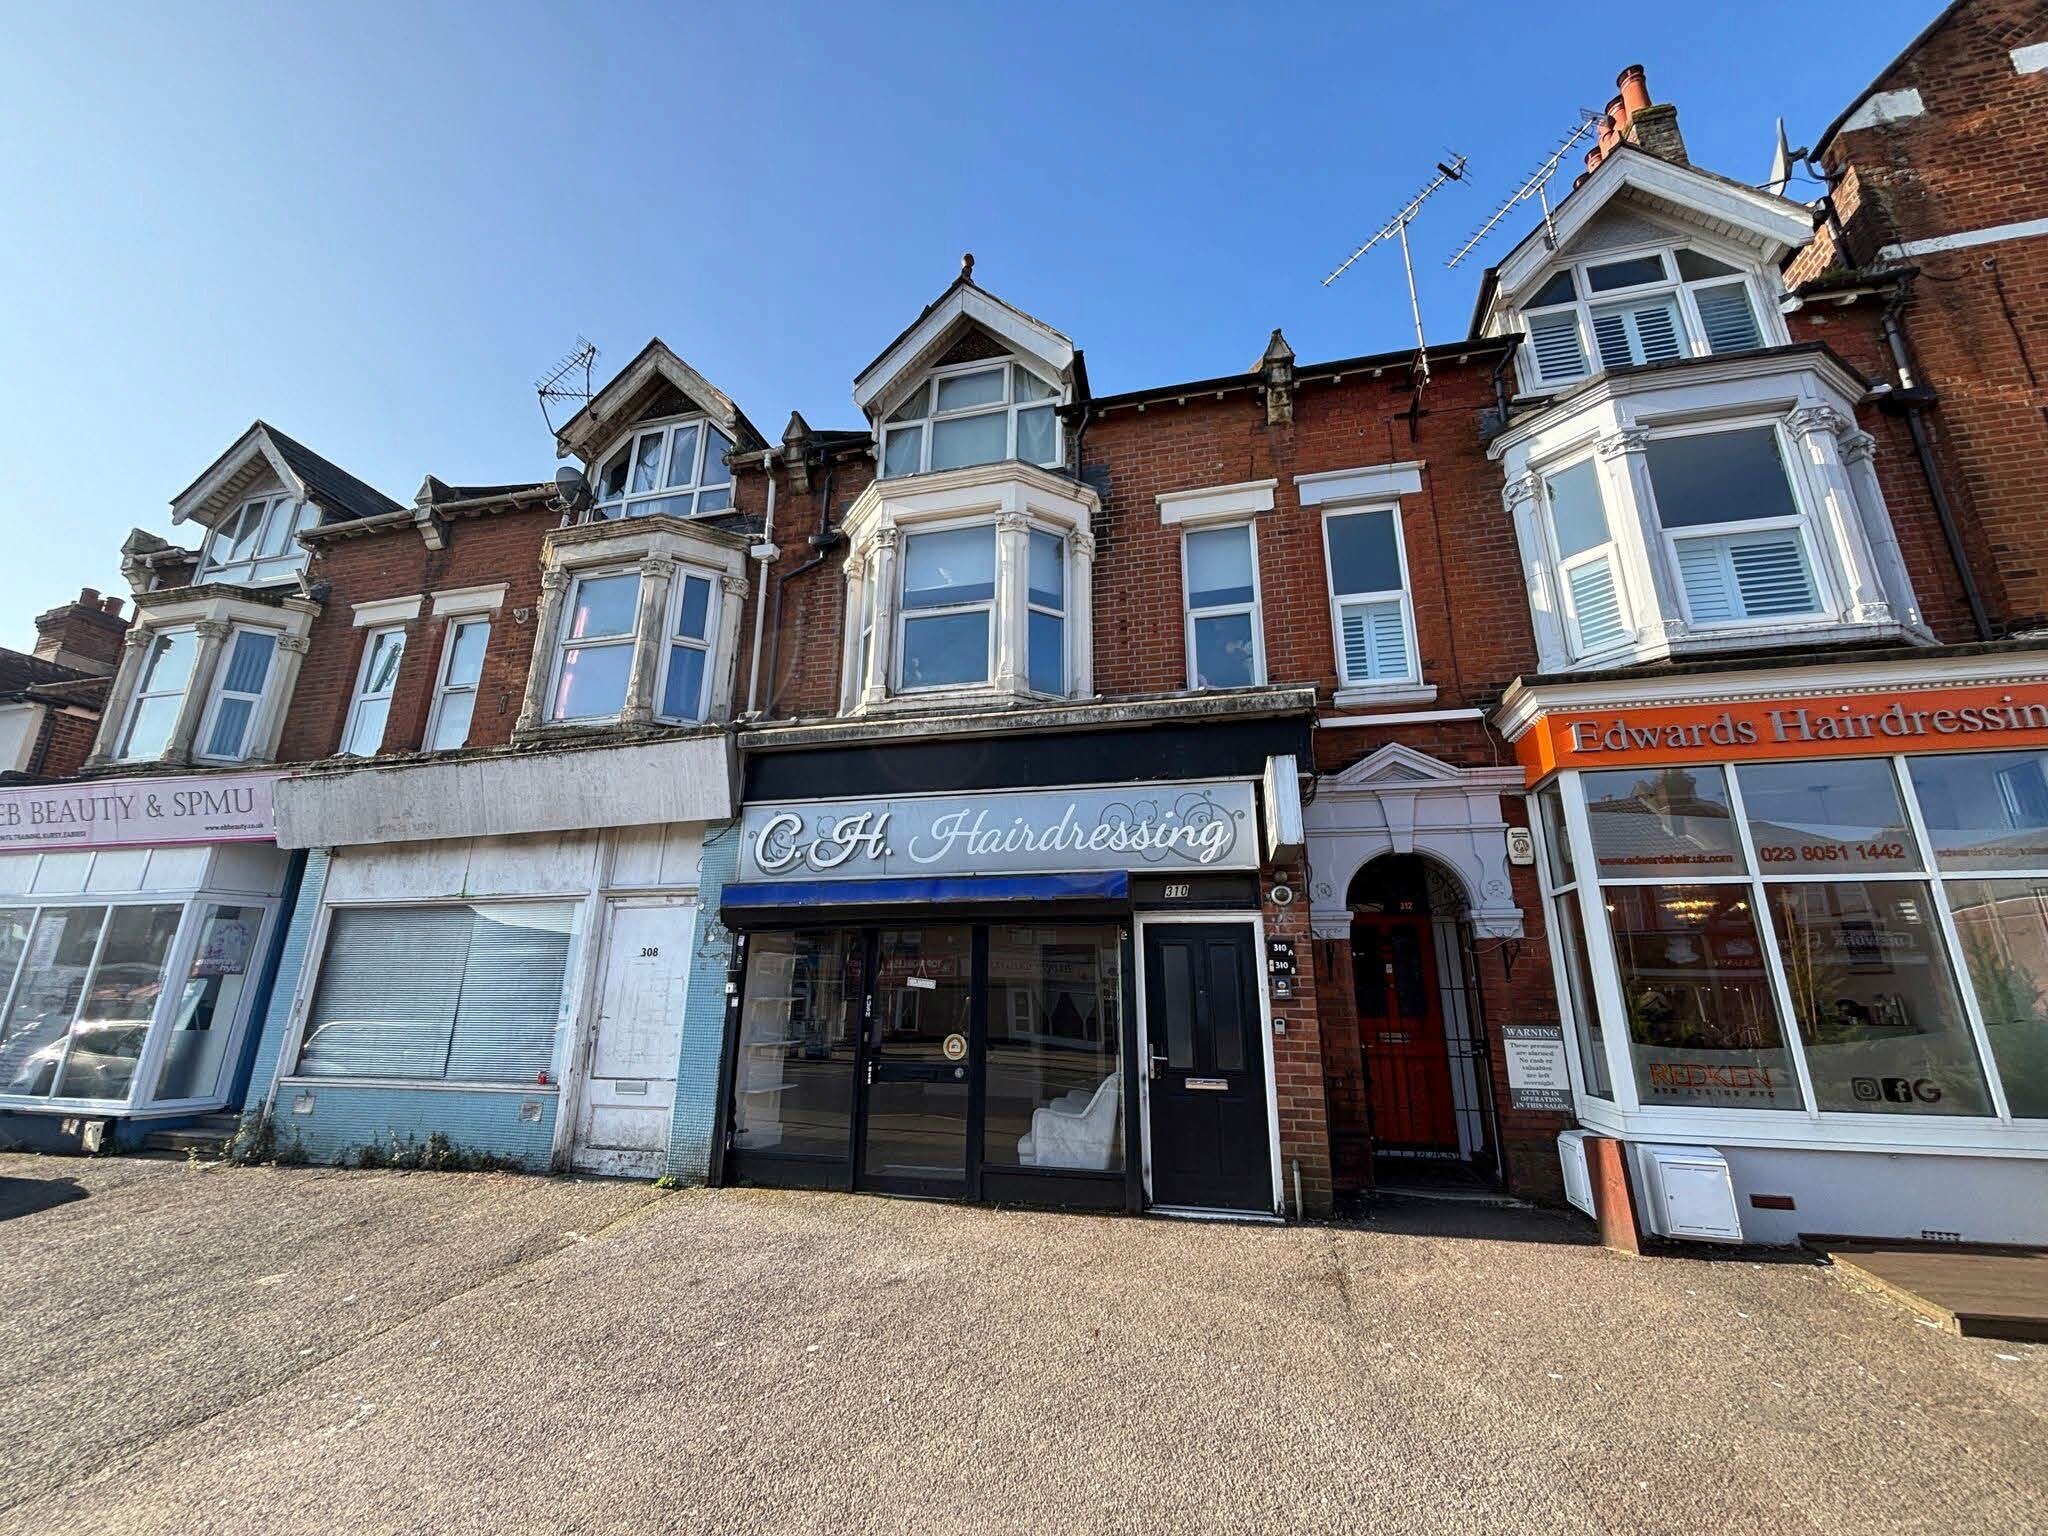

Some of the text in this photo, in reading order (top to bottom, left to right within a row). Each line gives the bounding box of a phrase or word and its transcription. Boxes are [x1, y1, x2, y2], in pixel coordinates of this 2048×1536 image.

[1570, 712, 1759, 753] Edwards
[30, 795, 136, 825] BEAUTY
[146, 793, 165, 819] &
[172, 787, 255, 817] SPMU
[908, 803, 1232, 865] Hairdressing
[1760, 843, 1907, 862] 023 8051 1442
[1165, 885, 1189, 898] 310
[640, 947, 659, 958] 308
[1273, 944, 1287, 952] 310
[1275, 961, 1289, 969] 310
[1506, 1028, 1559, 1037] WARNING
[1648, 1063, 1774, 1089] REDKEN
